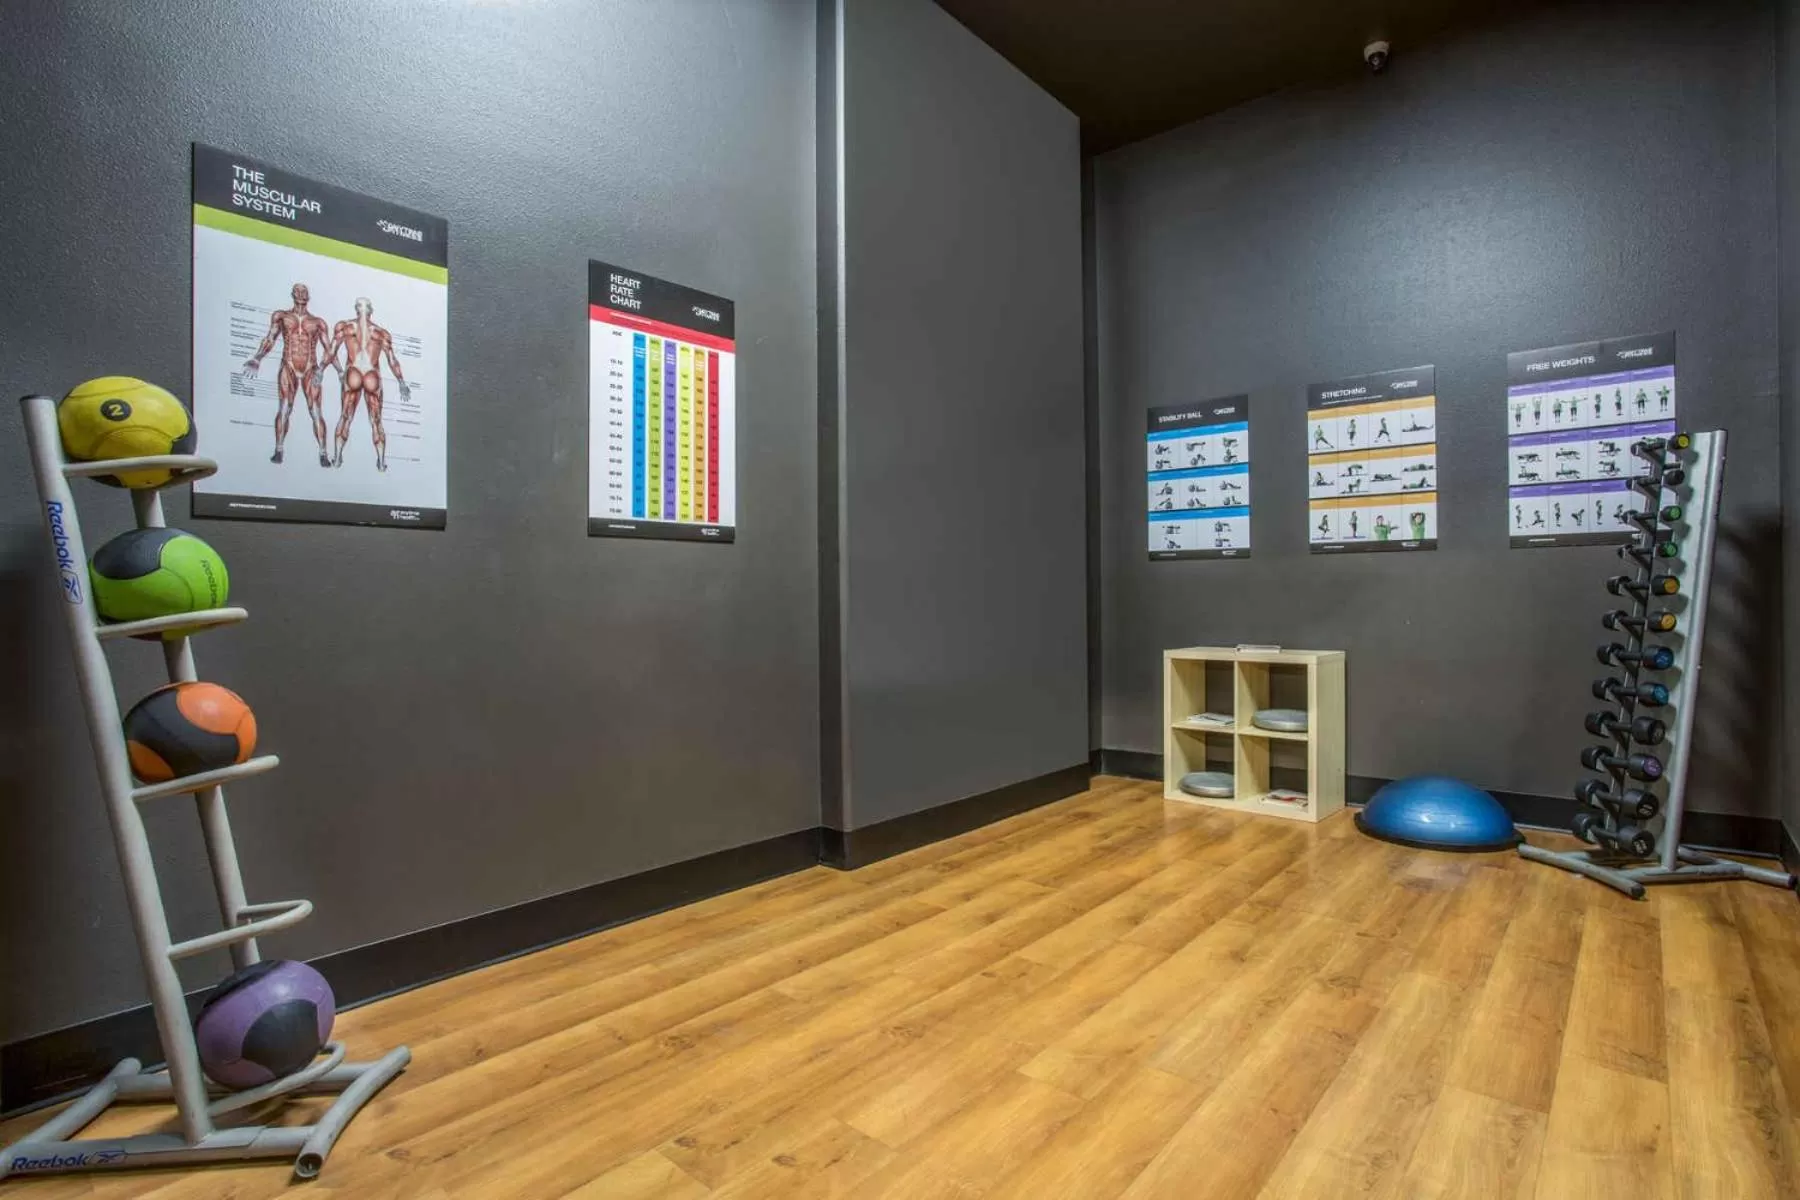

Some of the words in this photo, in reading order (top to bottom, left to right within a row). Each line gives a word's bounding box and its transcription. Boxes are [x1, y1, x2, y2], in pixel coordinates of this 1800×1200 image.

[232, 164, 265, 185] THE
[233, 178, 321, 214] MUSCULAR
[232, 193, 296, 221] SYSTEM
[610, 273, 641, 289] HEART
[610, 283, 634, 298] RATE
[610, 294, 642, 310] CHART
[1526, 361, 1550, 372] FREE
[1552, 355, 1596, 369] WEIGHTS
[1321, 387, 1367, 399] STRETCHING
[109, 404, 124, 417] 2
[1187, 410, 1203, 419] BALL
[46, 501, 74, 569] Reebok
[11, 1152, 89, 1171] Reebok
